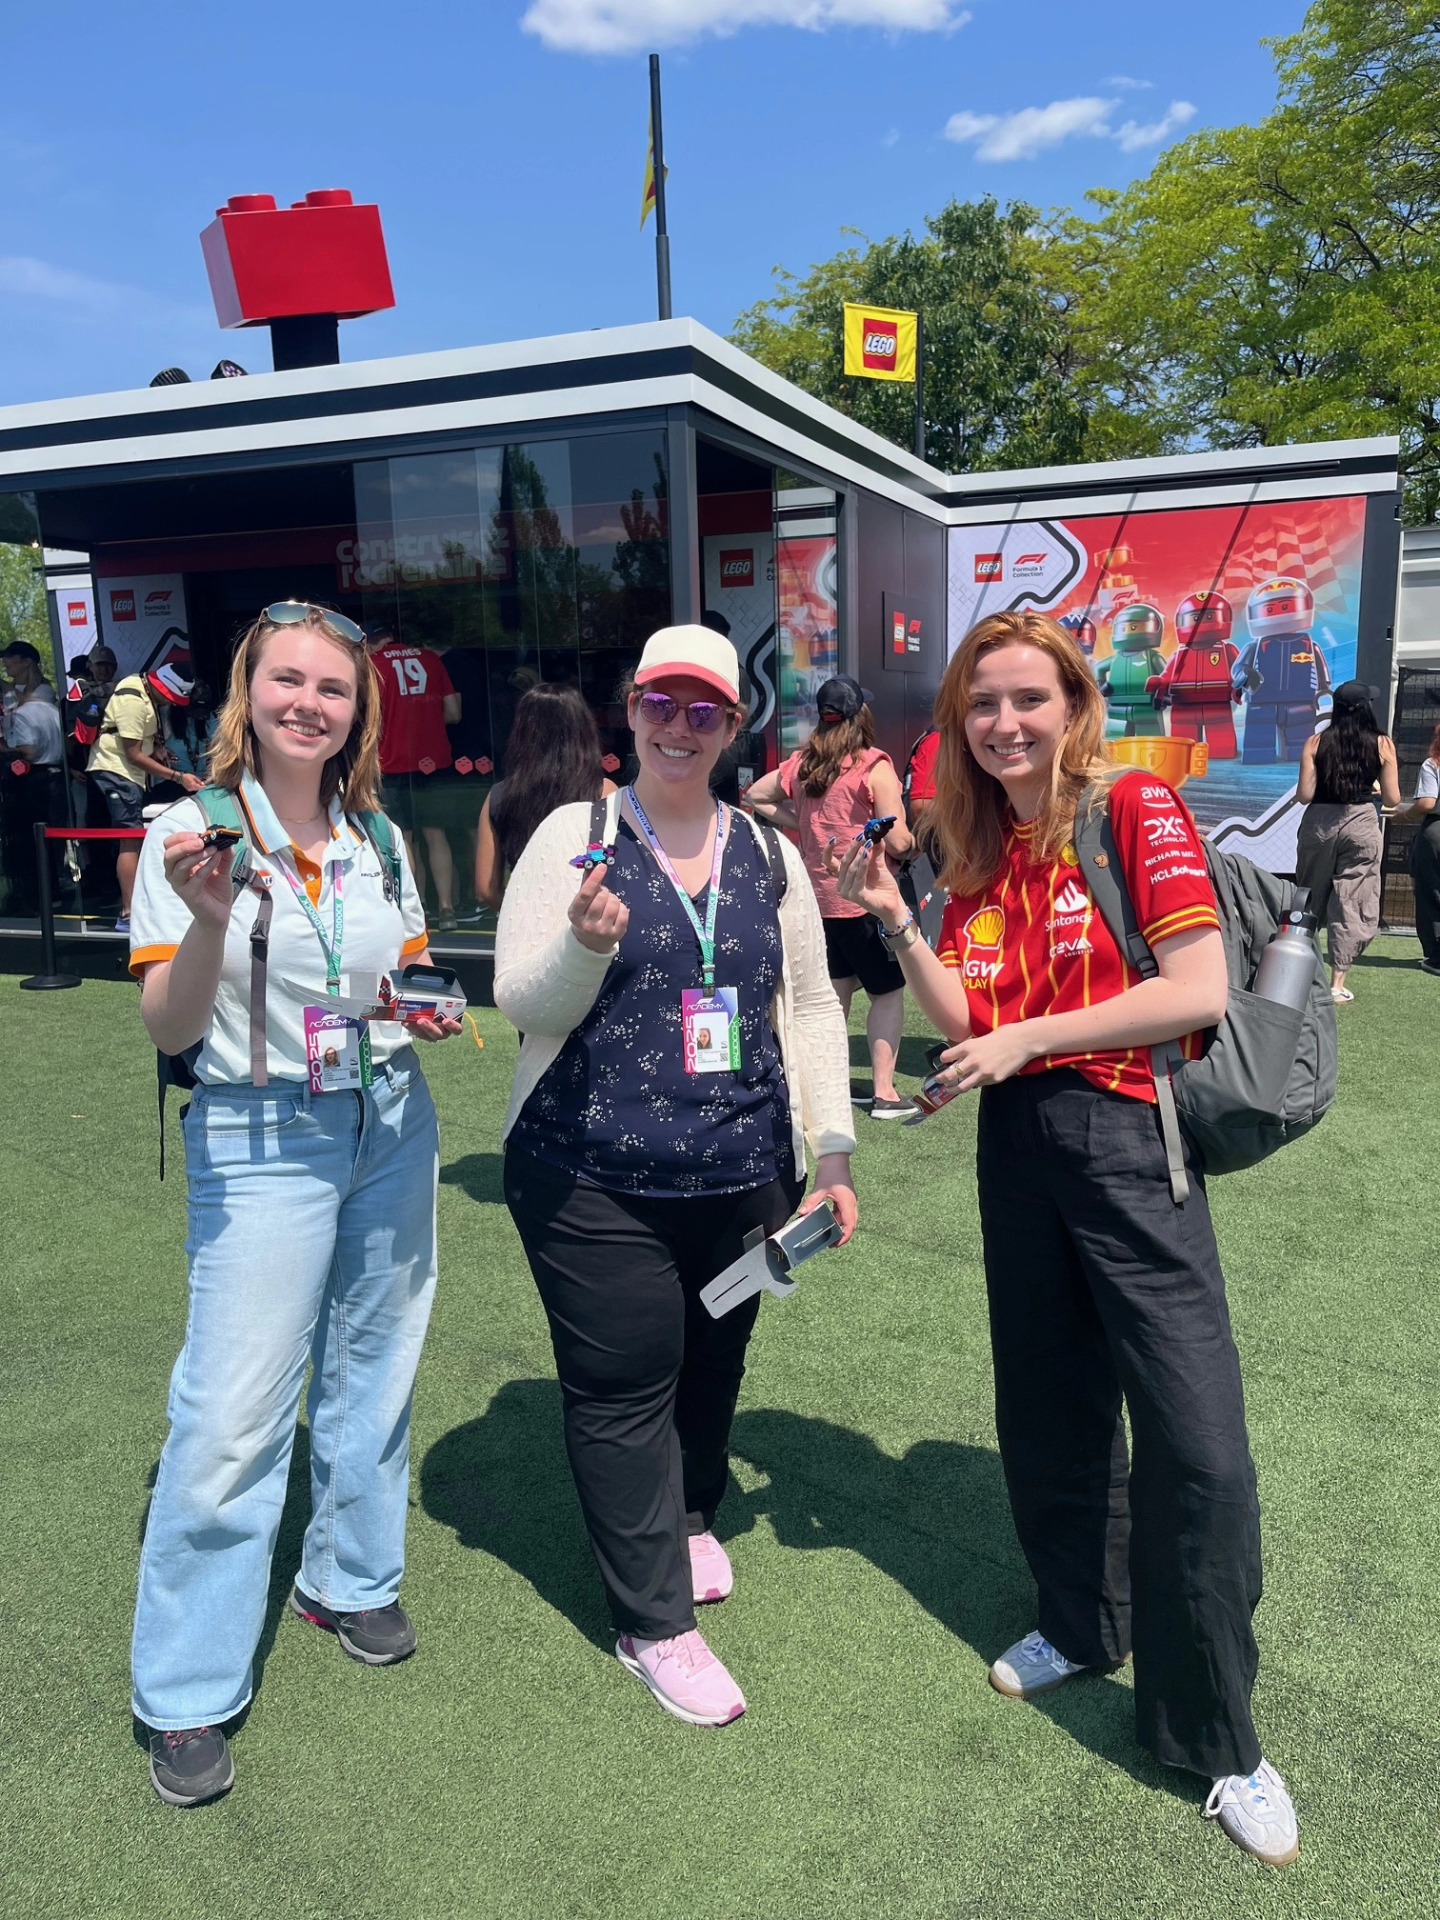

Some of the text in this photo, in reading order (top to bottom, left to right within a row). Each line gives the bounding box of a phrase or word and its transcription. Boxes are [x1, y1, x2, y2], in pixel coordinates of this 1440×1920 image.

[865, 334, 896, 355] LEGO
[1014, 553, 1049, 565] F1
[723, 561, 751, 576] LEGO
[977, 561, 1001, 574] LEGO
[113, 600, 133, 611] LEGO
[69, 608, 86, 619] LEGO
[383, 648, 422, 658] DAVIES
[392, 658, 428, 695] 19
[1141, 786, 1172, 800] aws
[1143, 815, 1187, 841] DXC
[335, 902, 343, 940] PADDOCK
[1064, 948, 1095, 958] LOGISTICS
[686, 1002, 724, 1010] ACADEMY
[309, 1018, 352, 1029] ACADEMY
[685, 1015, 697, 1072] 2025
[731, 1020, 740, 1068] PADDOCK
[309, 1032, 323, 1091] 2025
[361, 1035, 374, 1085] PADDOCK
